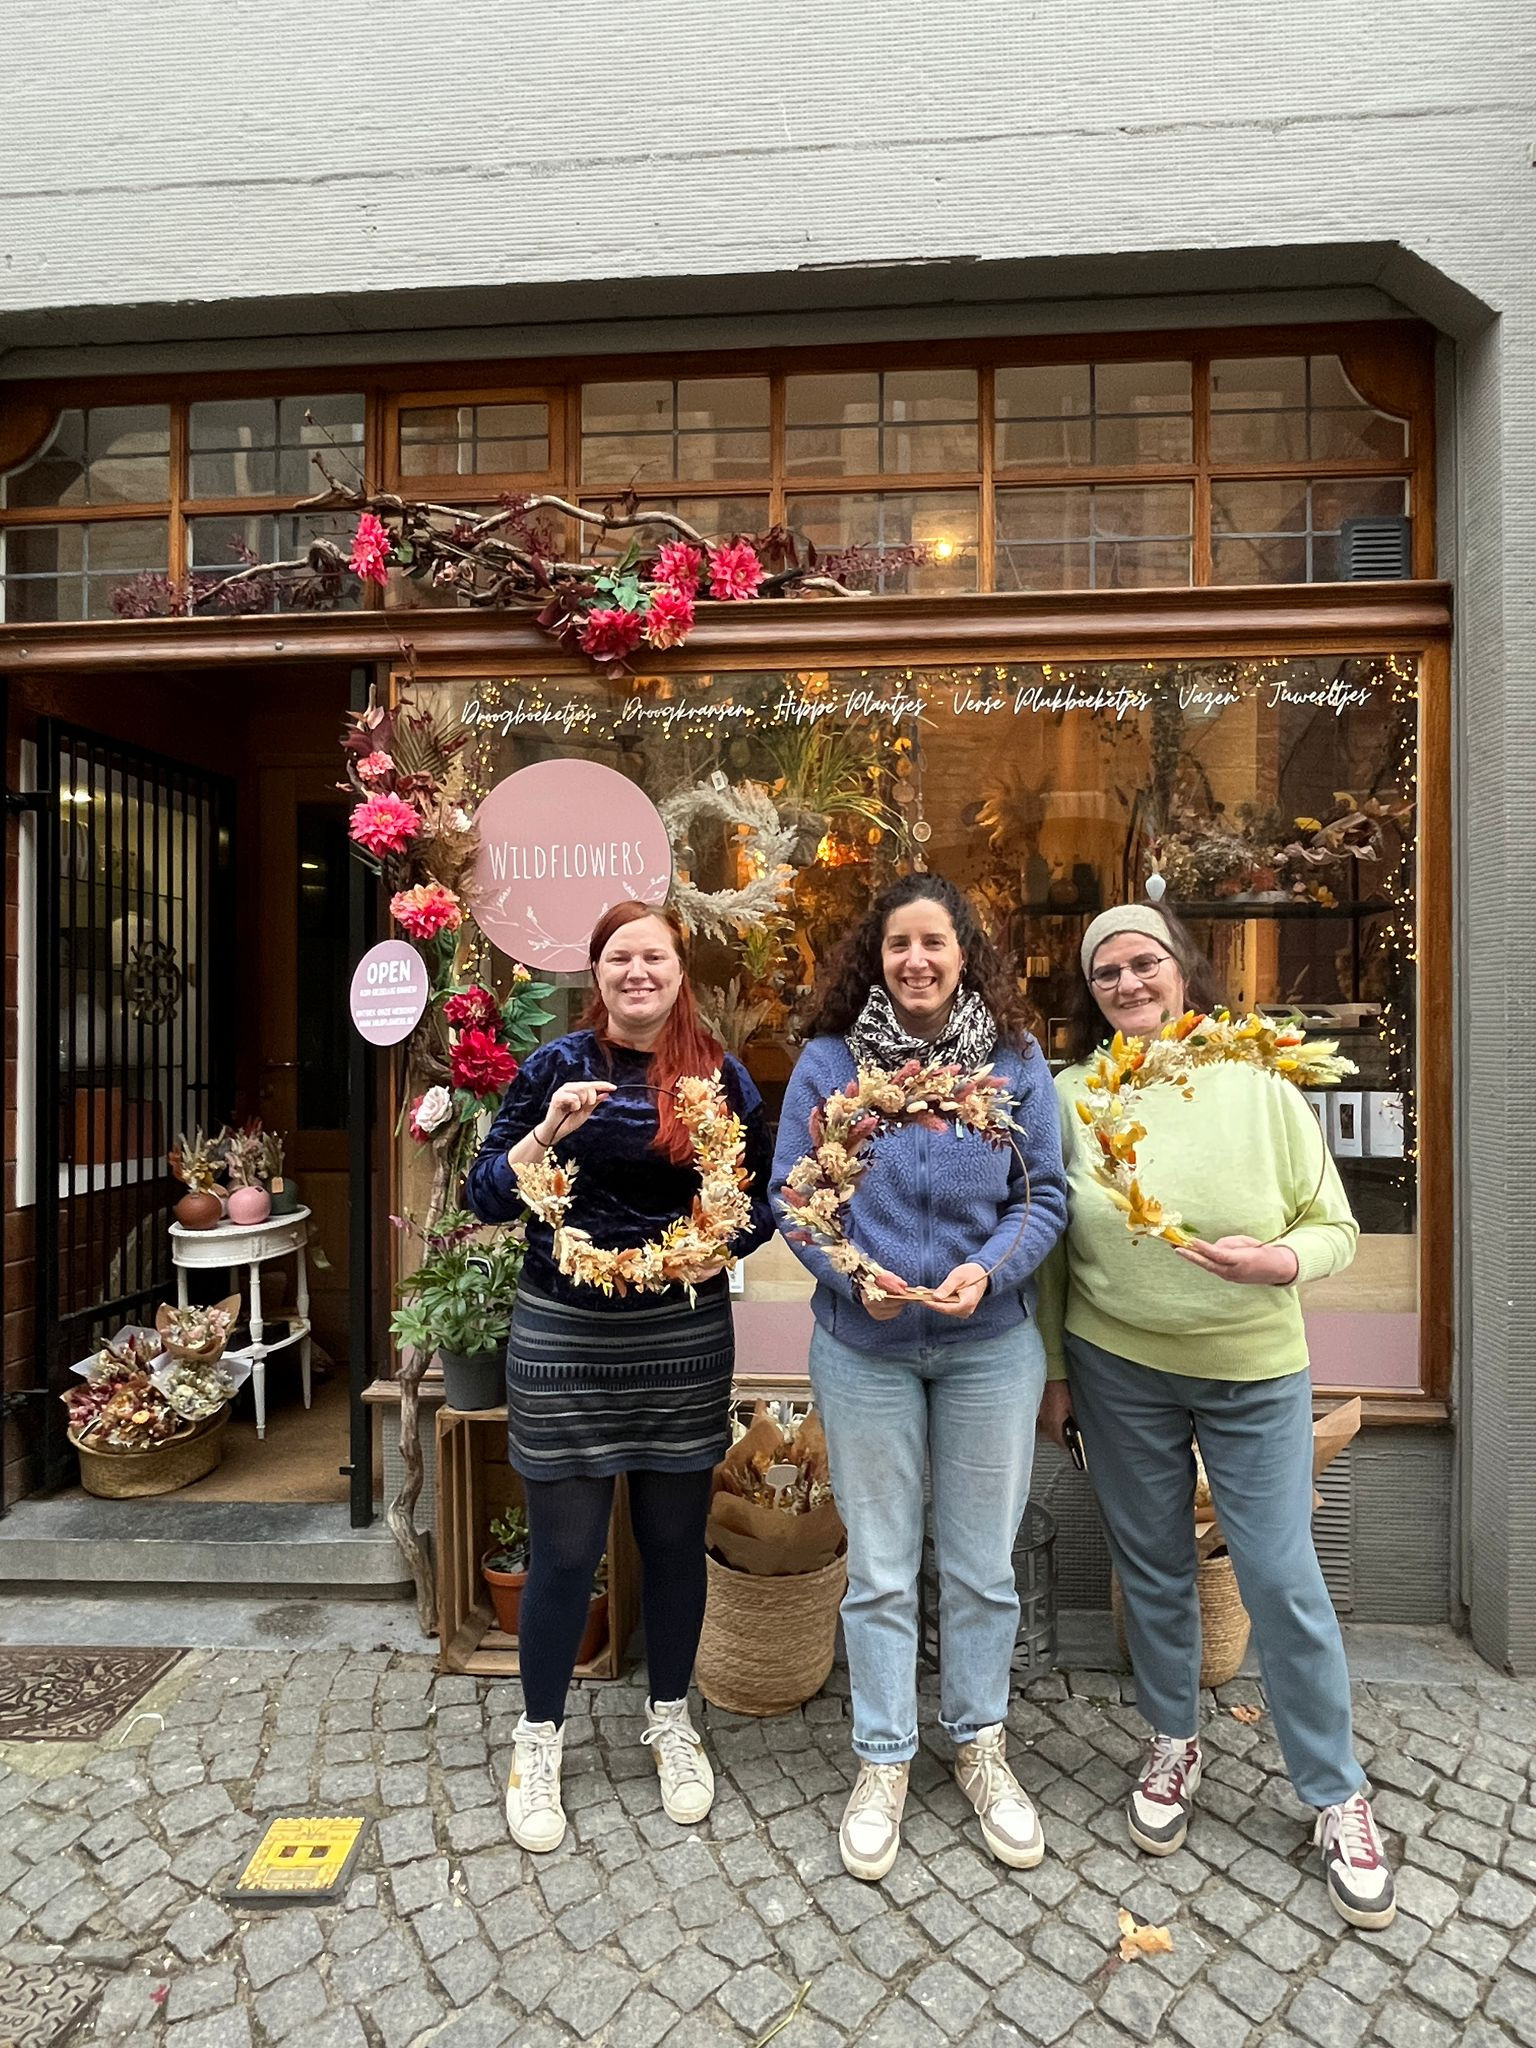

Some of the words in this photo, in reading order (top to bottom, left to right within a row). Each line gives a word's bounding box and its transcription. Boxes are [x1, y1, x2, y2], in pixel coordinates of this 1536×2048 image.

[461, 699, 593, 736] Droogboeketjes
[622, 697, 750, 732] Droogkransen
[777, 690, 838, 725] Hippe
[845, 689, 927, 726] Plantjes
[953, 689, 1006, 715] Verse
[1013, 684, 1152, 721] Plukboeketjes
[1179, 683, 1240, 714] Vazen
[1266, 678, 1372, 716] Juweeltjes
[489, 841, 645, 880] WILDFLOWERS
[366, 959, 412, 985] OPEN
